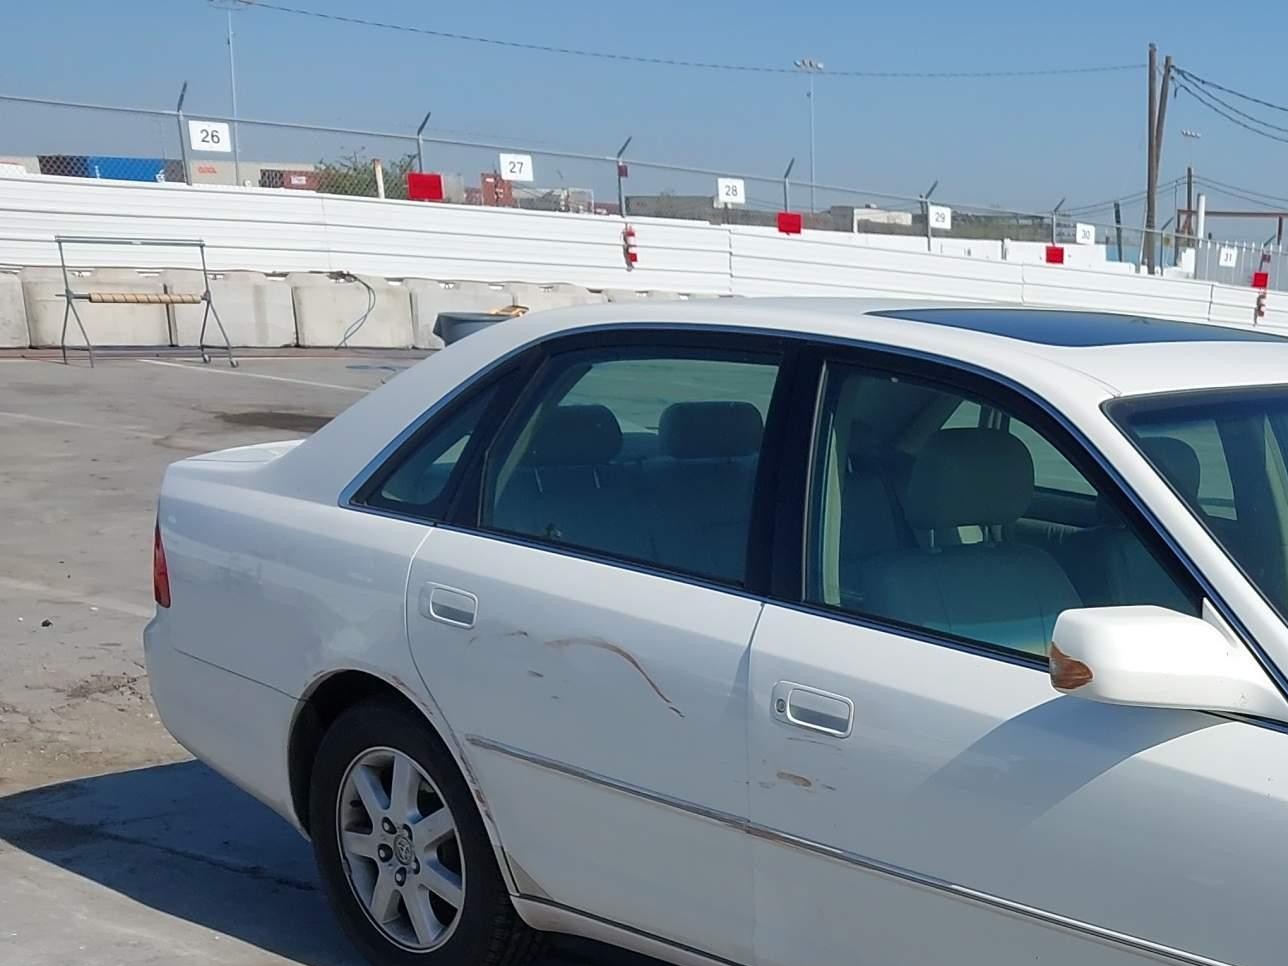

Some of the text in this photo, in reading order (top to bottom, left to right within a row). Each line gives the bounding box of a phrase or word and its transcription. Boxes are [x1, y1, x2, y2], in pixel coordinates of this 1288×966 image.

[199, 128, 221, 144] 26
[508, 160, 524, 174] 27
[724, 184, 738, 197] 28
